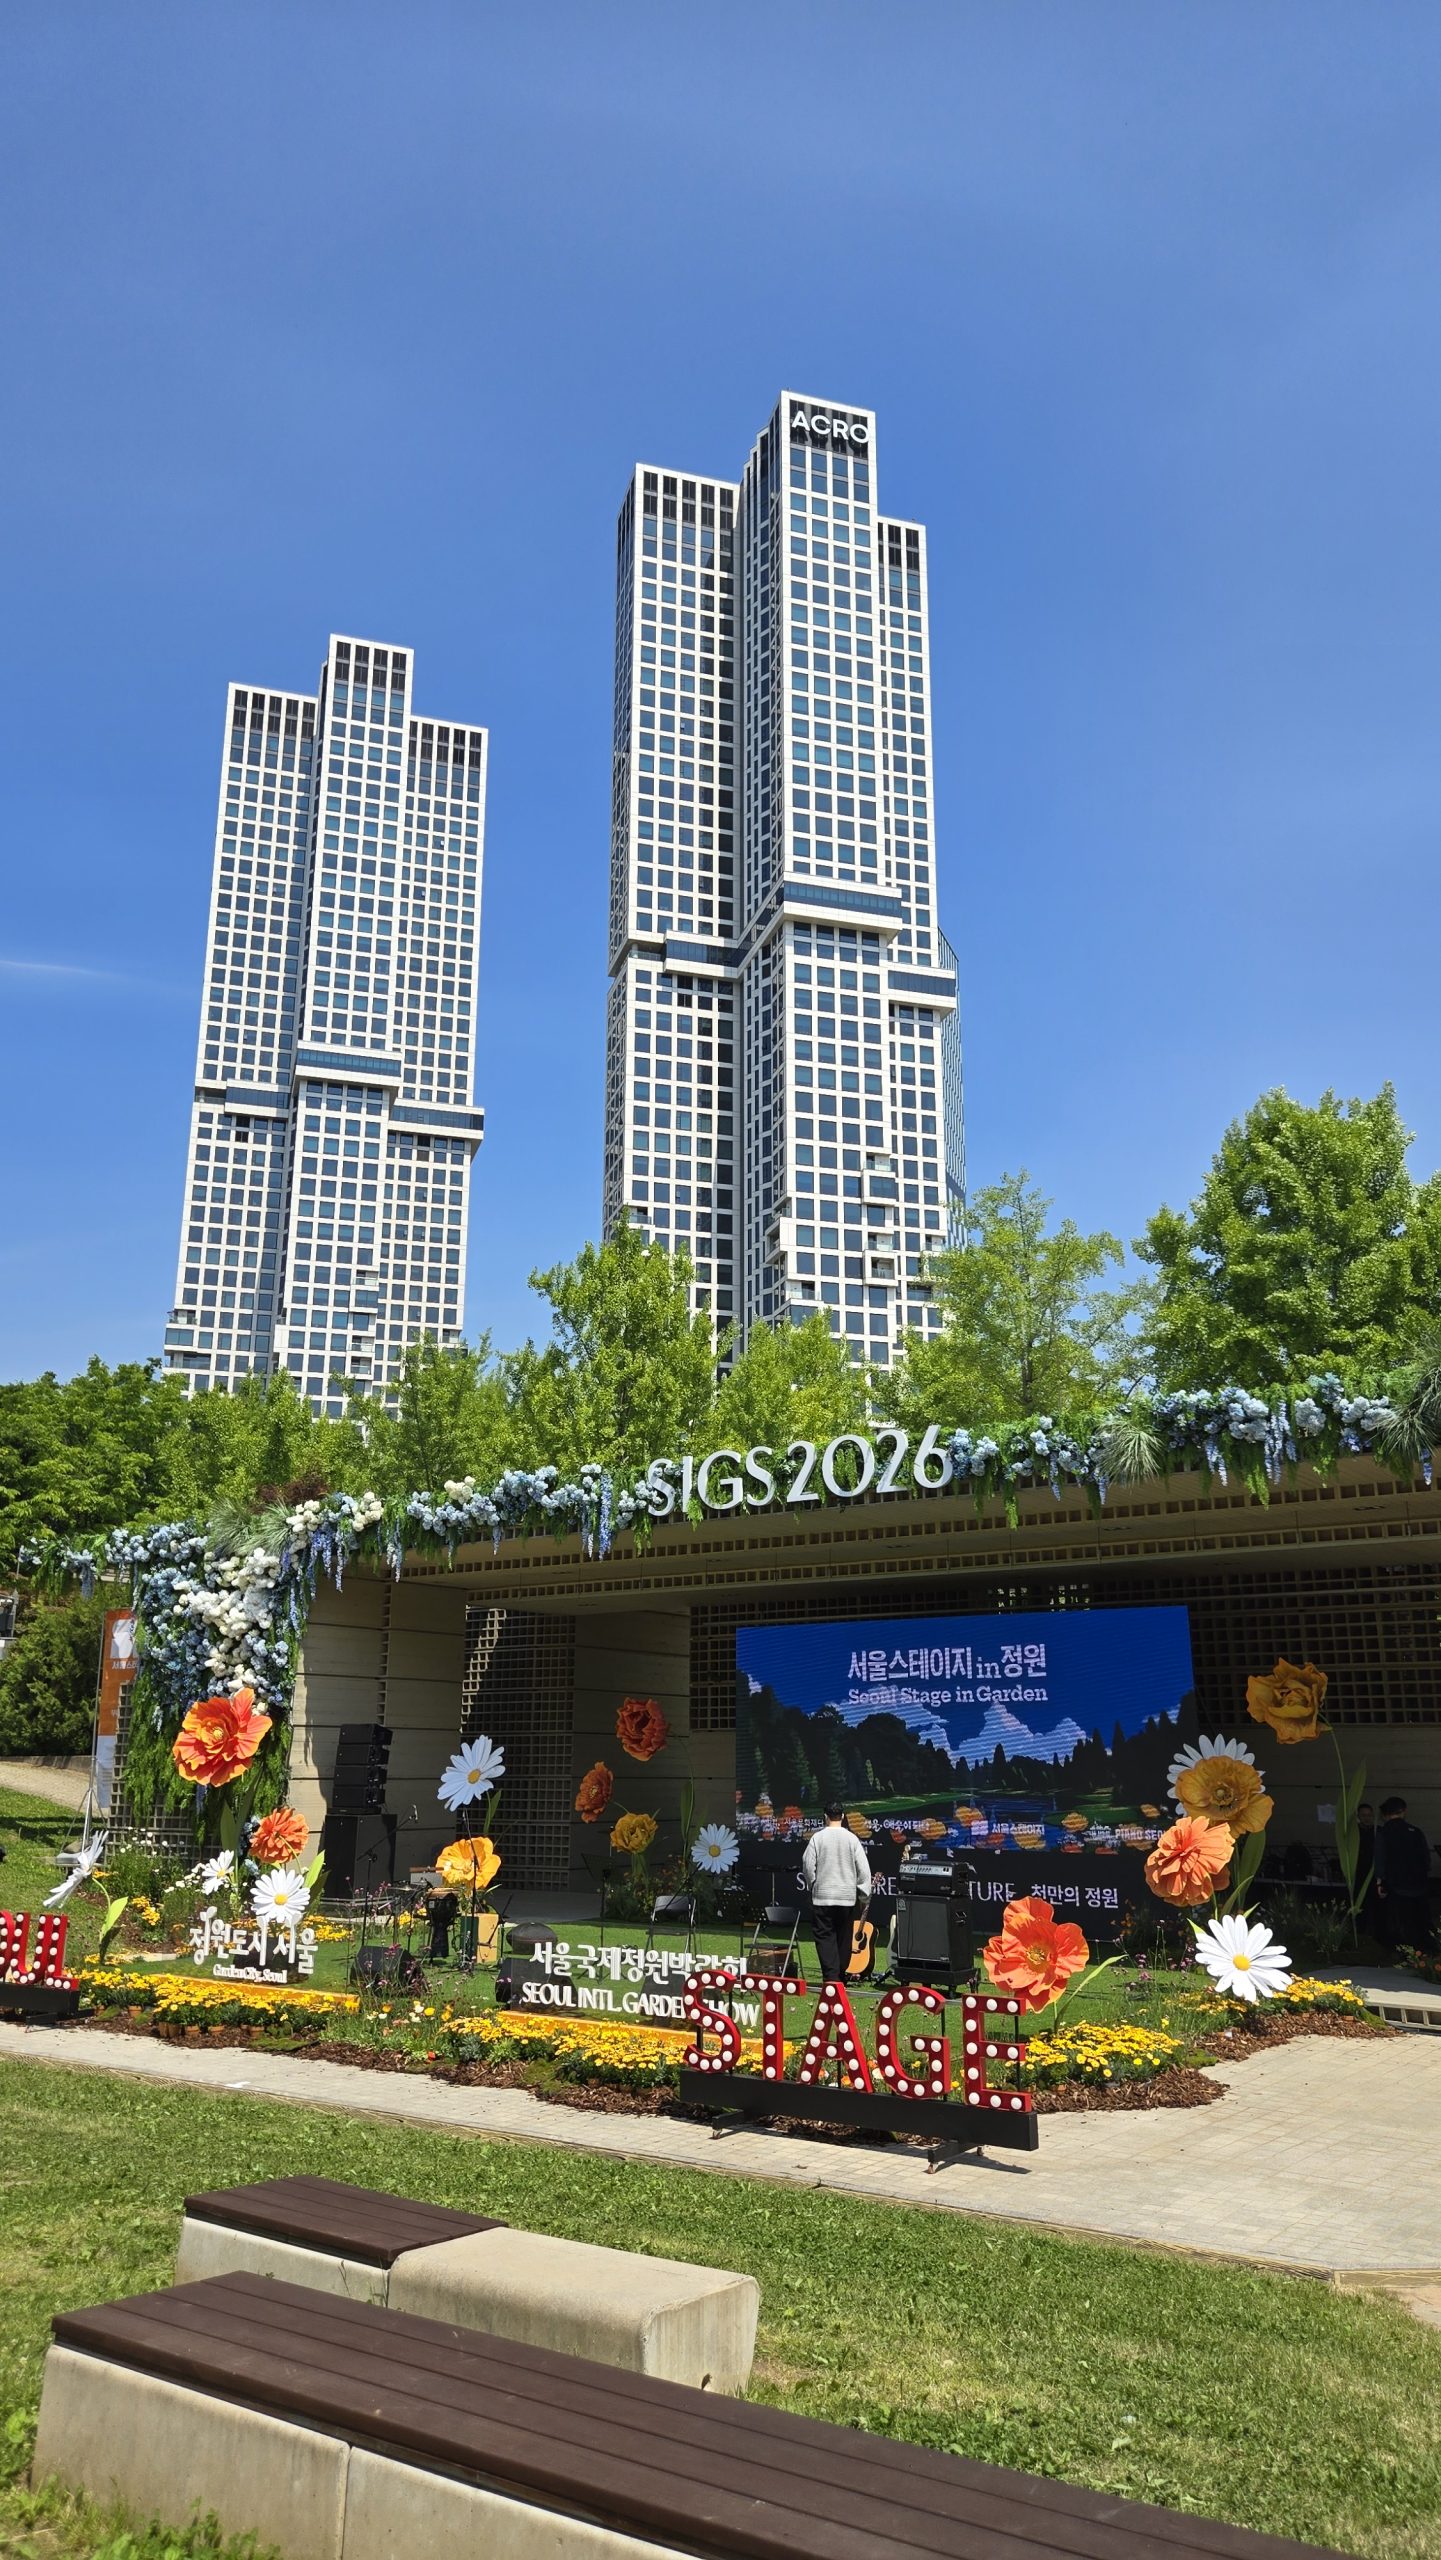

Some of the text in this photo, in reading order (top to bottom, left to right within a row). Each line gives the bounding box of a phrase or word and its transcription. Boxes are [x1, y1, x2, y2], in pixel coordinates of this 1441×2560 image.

[791, 411, 869, 444] ACRO
[848, 1685, 1049, 1708] Seoul Stage in Garden
[1144, 1829, 1164, 1841] SEO
[1031, 1883, 1119, 1909] 천만의 정원
[522, 1981, 576, 2008] SEOUL
[702, 1999, 761, 2027] HOW
[682, 1969, 1033, 2113] STAGE
